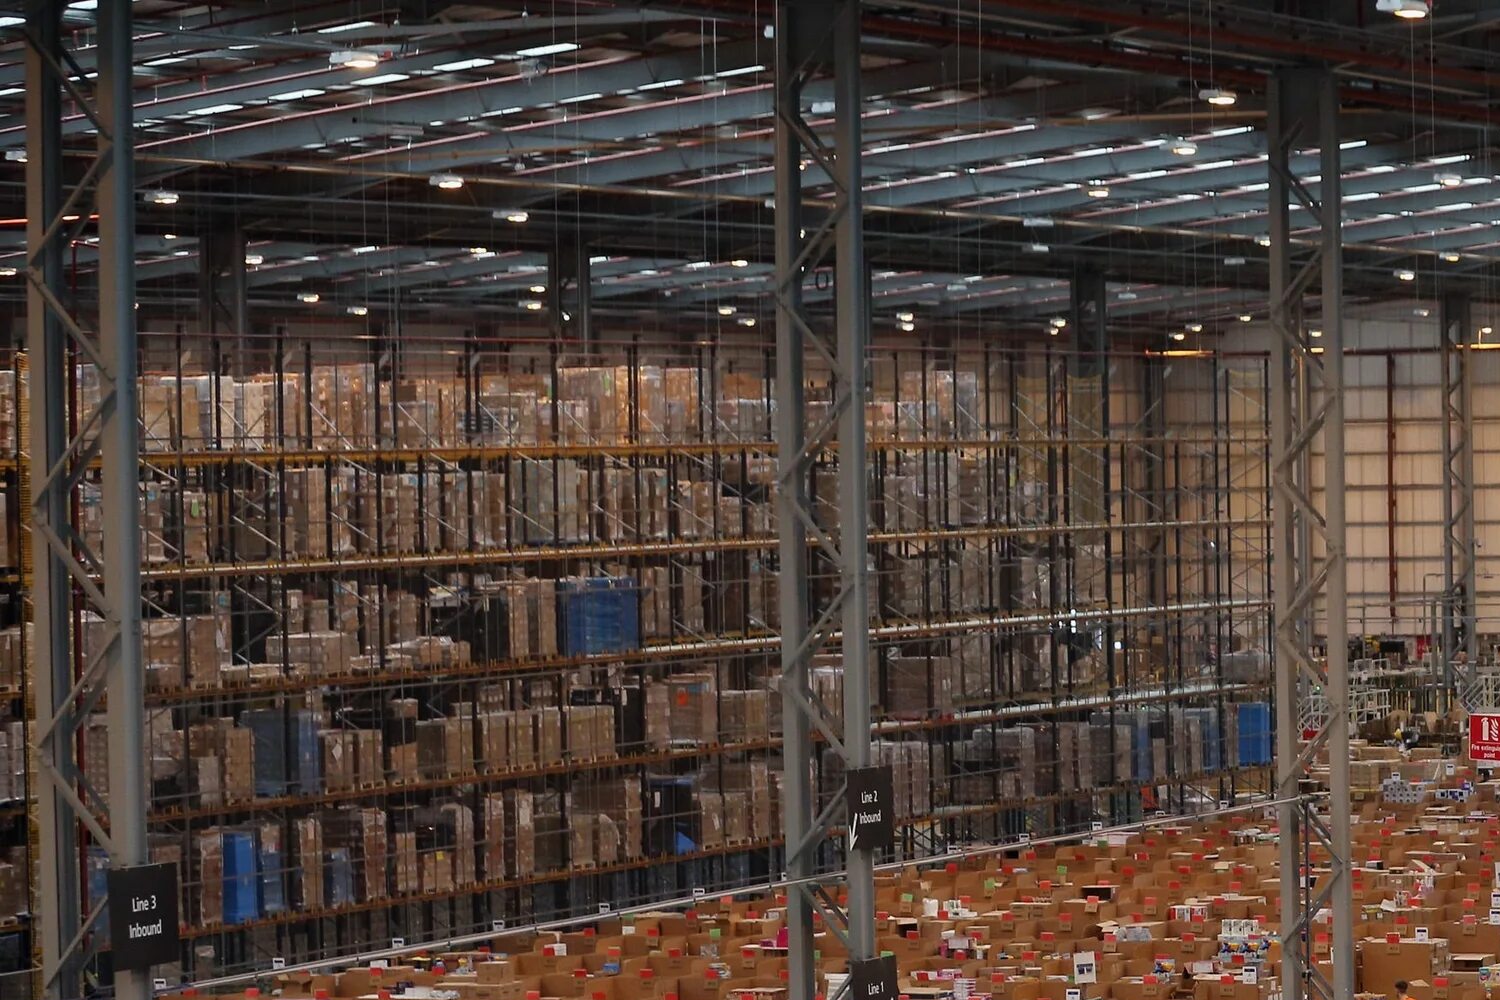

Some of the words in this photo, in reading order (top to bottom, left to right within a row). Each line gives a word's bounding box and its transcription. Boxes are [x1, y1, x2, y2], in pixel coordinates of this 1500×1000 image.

[861, 791, 873, 804] Line
[873, 790, 878, 802] 2
[859, 809, 882, 824] Inbound
[132, 897, 150, 912] Line
[150, 895, 157, 910] 3
[129, 919, 162, 938] Inbound
[868, 983, 880, 996] Line
[880, 981, 884, 993] 1
